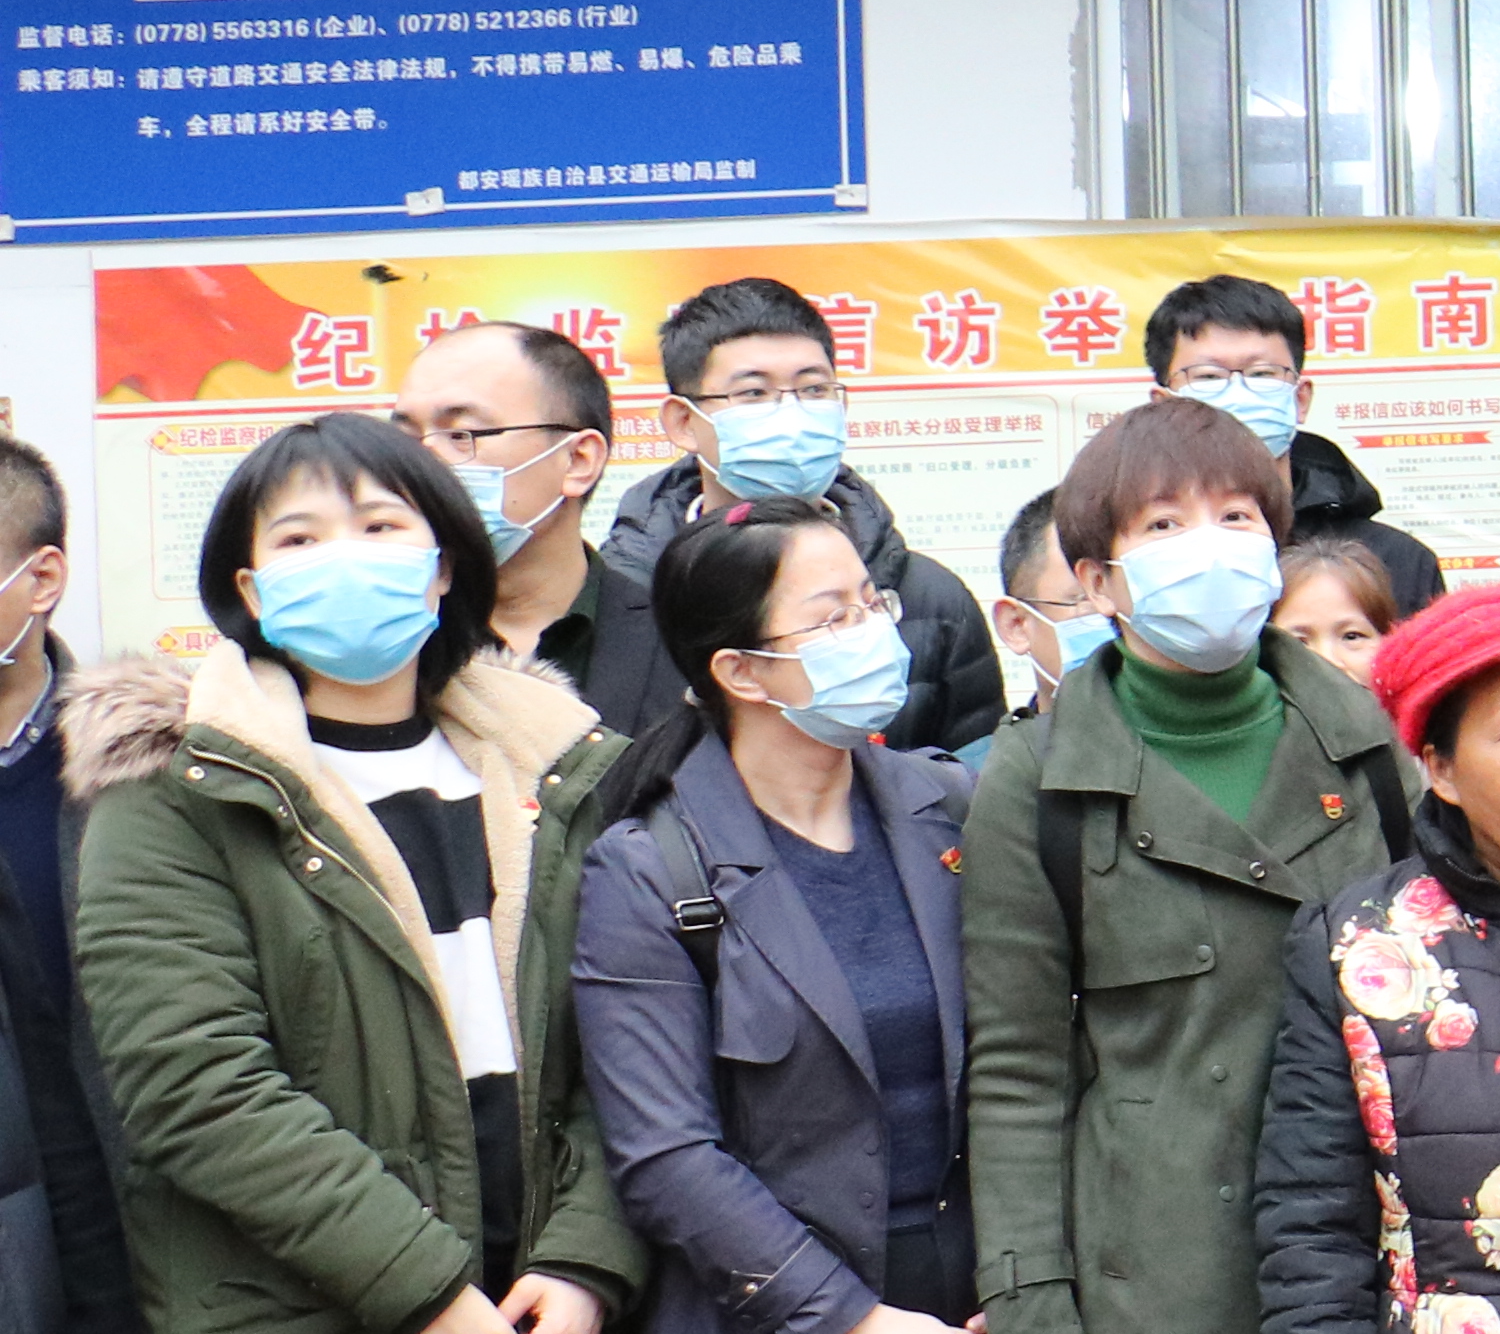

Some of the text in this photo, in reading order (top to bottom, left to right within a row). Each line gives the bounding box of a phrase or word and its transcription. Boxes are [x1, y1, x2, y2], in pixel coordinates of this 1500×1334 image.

[458, 158, 757, 191] 都安瑶族自治县交通运输局监制
